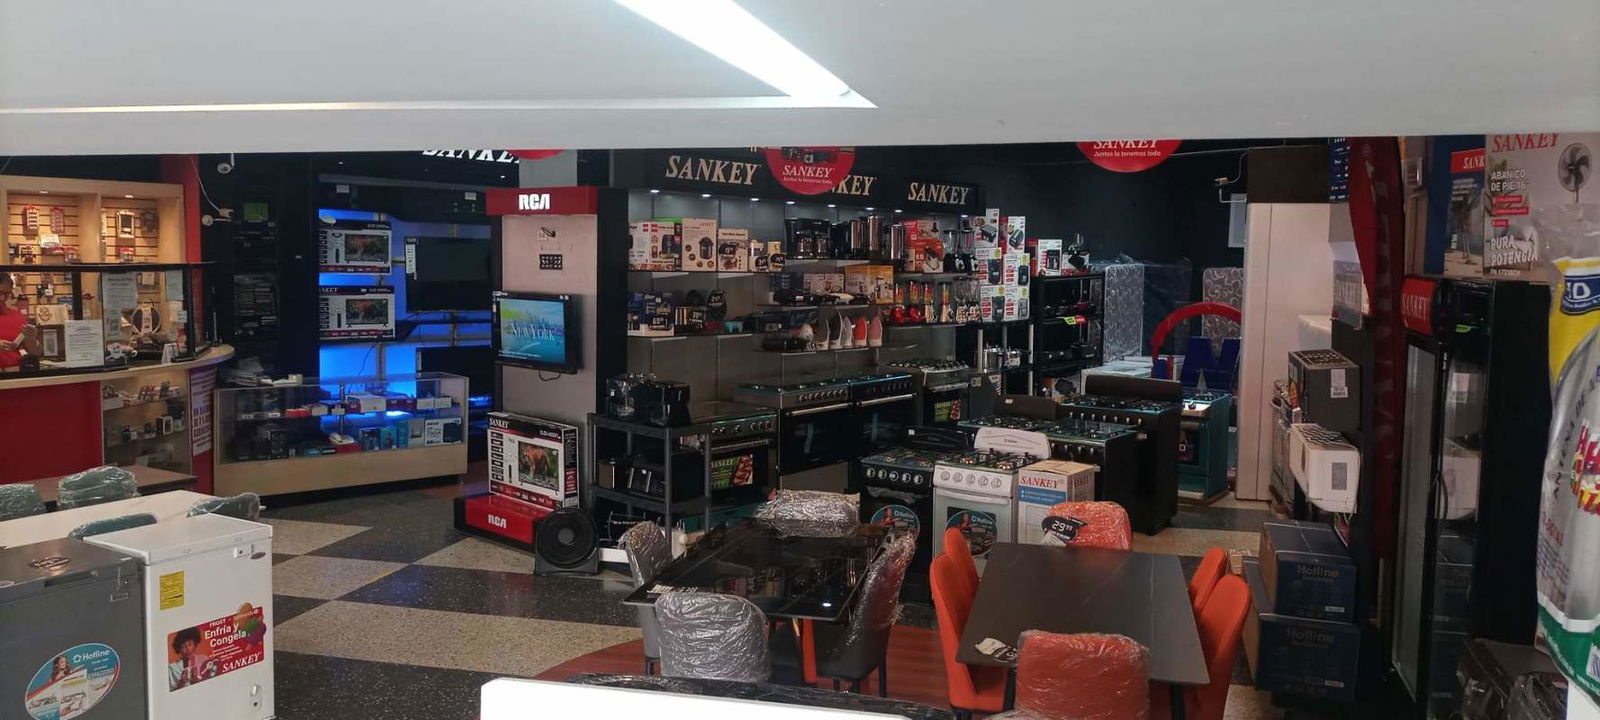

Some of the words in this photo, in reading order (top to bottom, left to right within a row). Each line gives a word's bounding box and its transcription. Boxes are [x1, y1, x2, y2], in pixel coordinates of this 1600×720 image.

[1492, 133, 1560, 153] SANKEY
[665, 155, 757, 186] SANKEY
[1463, 155, 1485, 170] SANK
[782, 164, 833, 178] SANKEY
[1491, 169, 1526, 180] ABANICO
[832, 174, 876, 197] KEY
[907, 181, 970, 206] SANKEY
[1491, 182, 1502, 191] DE
[1503, 181, 1515, 190] PIE
[519, 193, 550, 210] RCA
[1490, 235, 1515, 251] PURA
[1491, 248, 1538, 266] POTENCIA
[1021, 475, 1060, 489] SANKEY
[487, 514, 507, 528] RCA
[1052, 520, 1066, 532] 29
[204, 624, 231, 639] Enfría
[233, 622, 239, 634] y
[82, 649, 110, 661] Hotline
[222, 651, 261, 673] SANKEY
